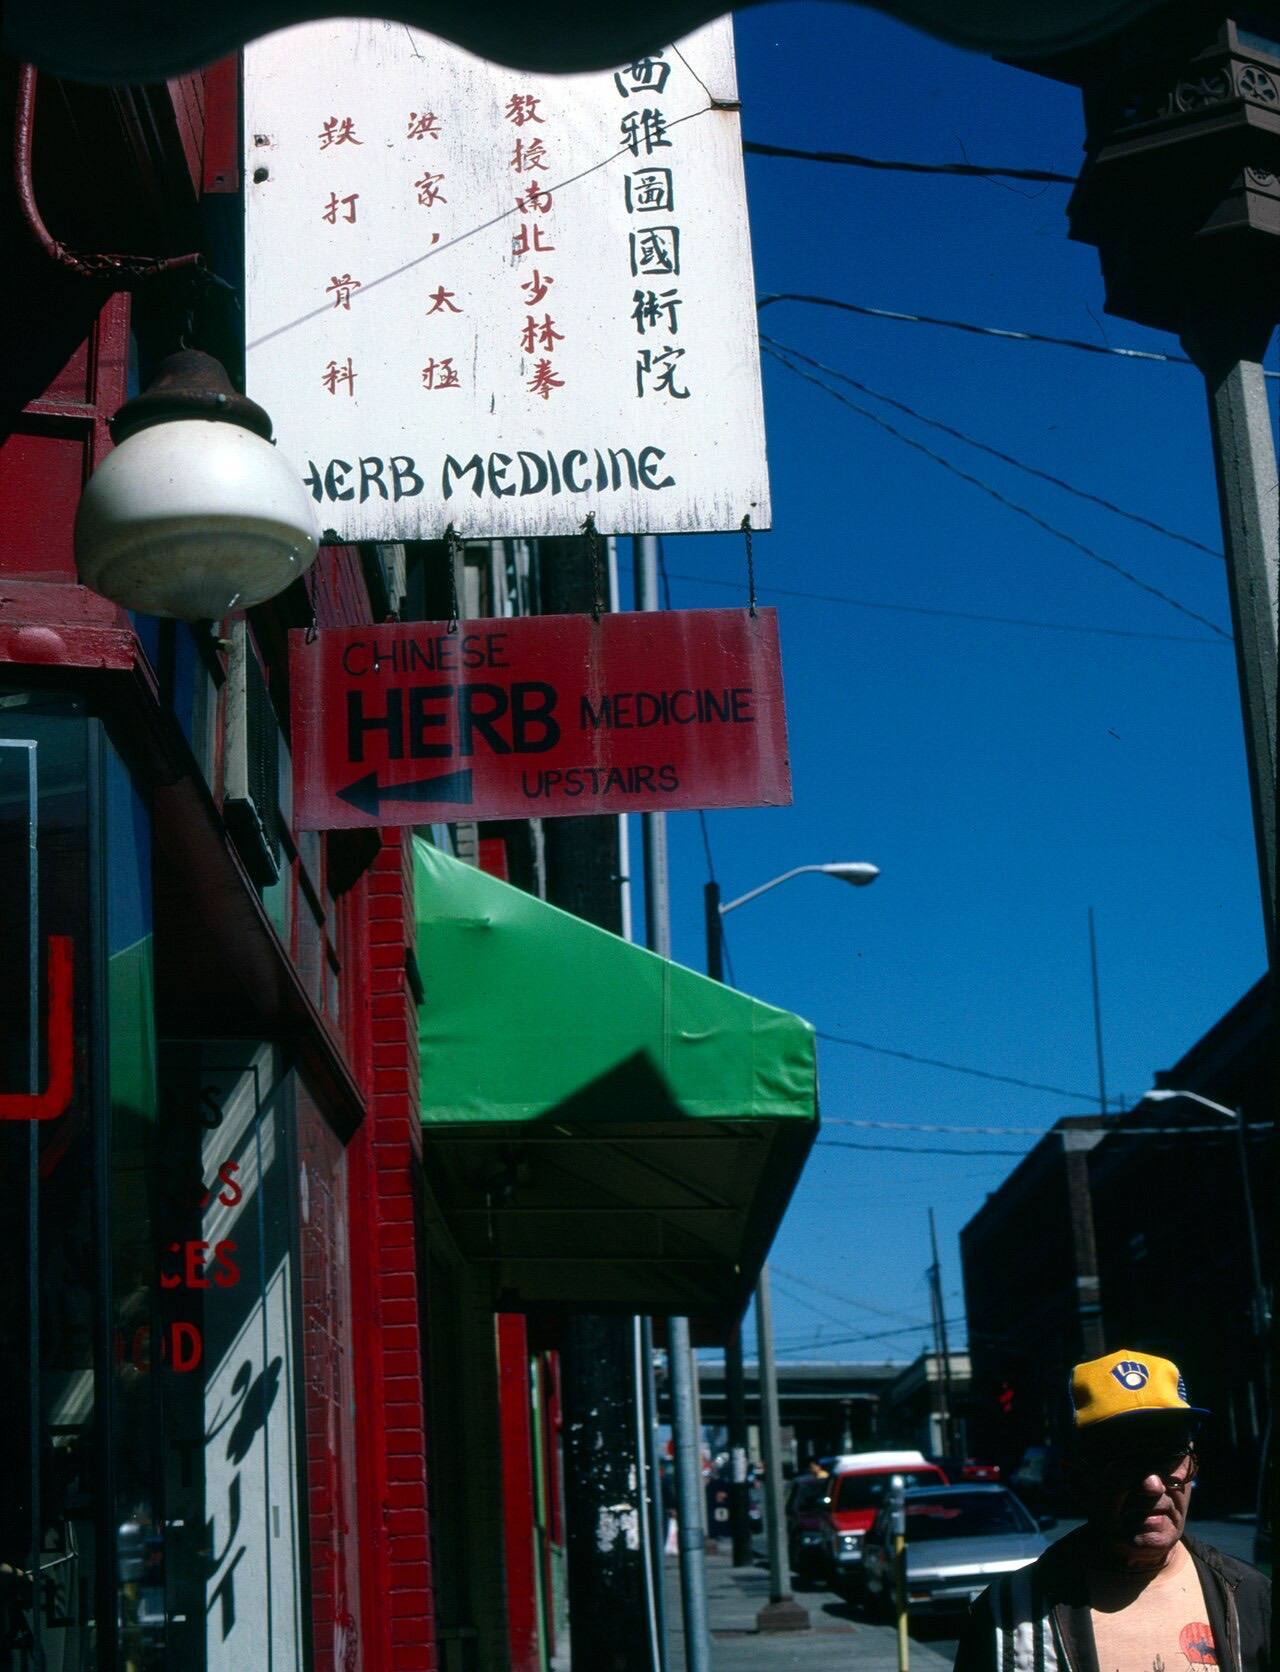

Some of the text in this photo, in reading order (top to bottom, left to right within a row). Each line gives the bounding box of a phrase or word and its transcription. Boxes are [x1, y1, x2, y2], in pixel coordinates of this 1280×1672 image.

[343, 634, 509, 674] CHINESE
[347, 682, 753, 762] HERB MEDICINE
[521, 765, 680, 799] UPSTAIRS
